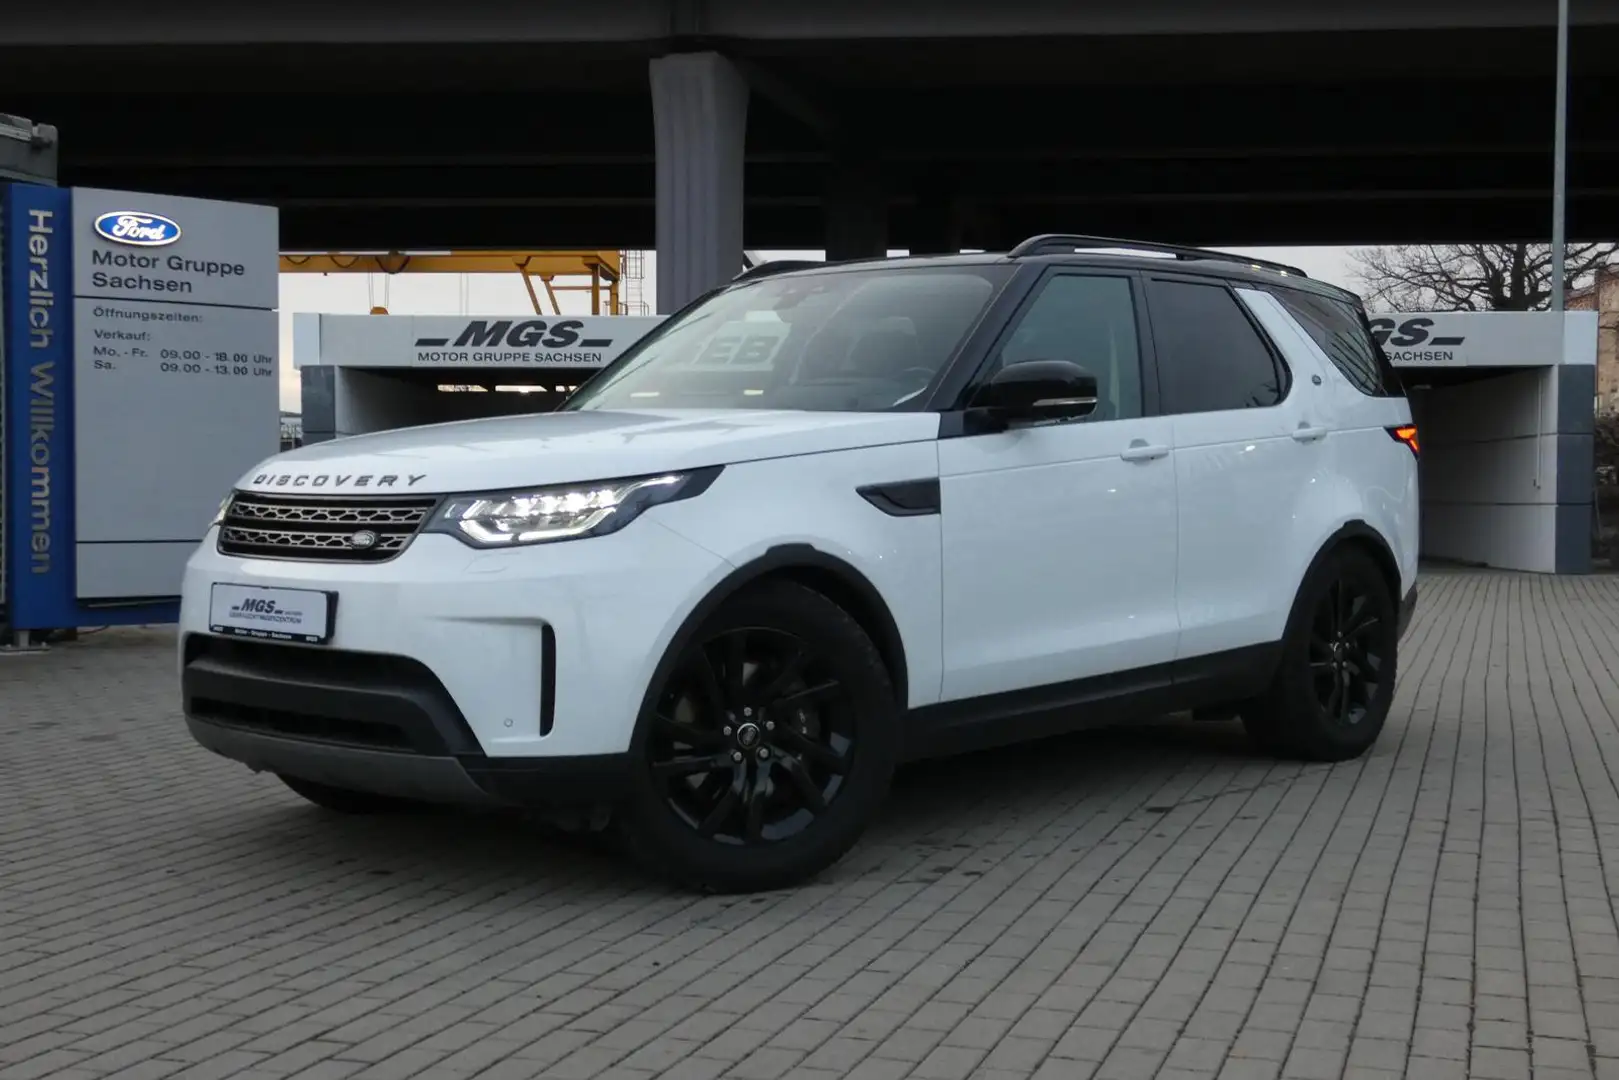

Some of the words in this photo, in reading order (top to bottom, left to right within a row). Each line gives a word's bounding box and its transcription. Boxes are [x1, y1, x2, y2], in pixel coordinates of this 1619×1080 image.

[112, 215, 166, 240] Ford
[92, 250, 159, 269] Motor
[166, 255, 245, 278] Gruppe
[28, 209, 54, 348] Herzlich
[92, 271, 192, 293] Sachsen
[92, 305, 203, 323] Öffnungszeiten:
[93, 328, 151, 342] Verkauf:
[452, 319, 584, 348] MGS
[93, 345, 121, 358] Mo.
[131, 347, 149, 358] Fr.
[160, 348, 201, 360] 09.00
[253, 354, 273, 365] Uhr
[417, 352, 469, 362] MOTOR
[473, 352, 530, 362] GRUPPE
[534, 352, 602, 362] SACHSEN
[1386, 351, 1454, 361] SACHSEN
[93, 359, 117, 370] Sa.
[160, 362, 201, 373] 09.00
[253, 366, 273, 377] Uhr
[30, 361, 55, 573] Willkommen
[253, 474, 427, 487] DISCOVERY
[240, 598, 277, 614] MGS
